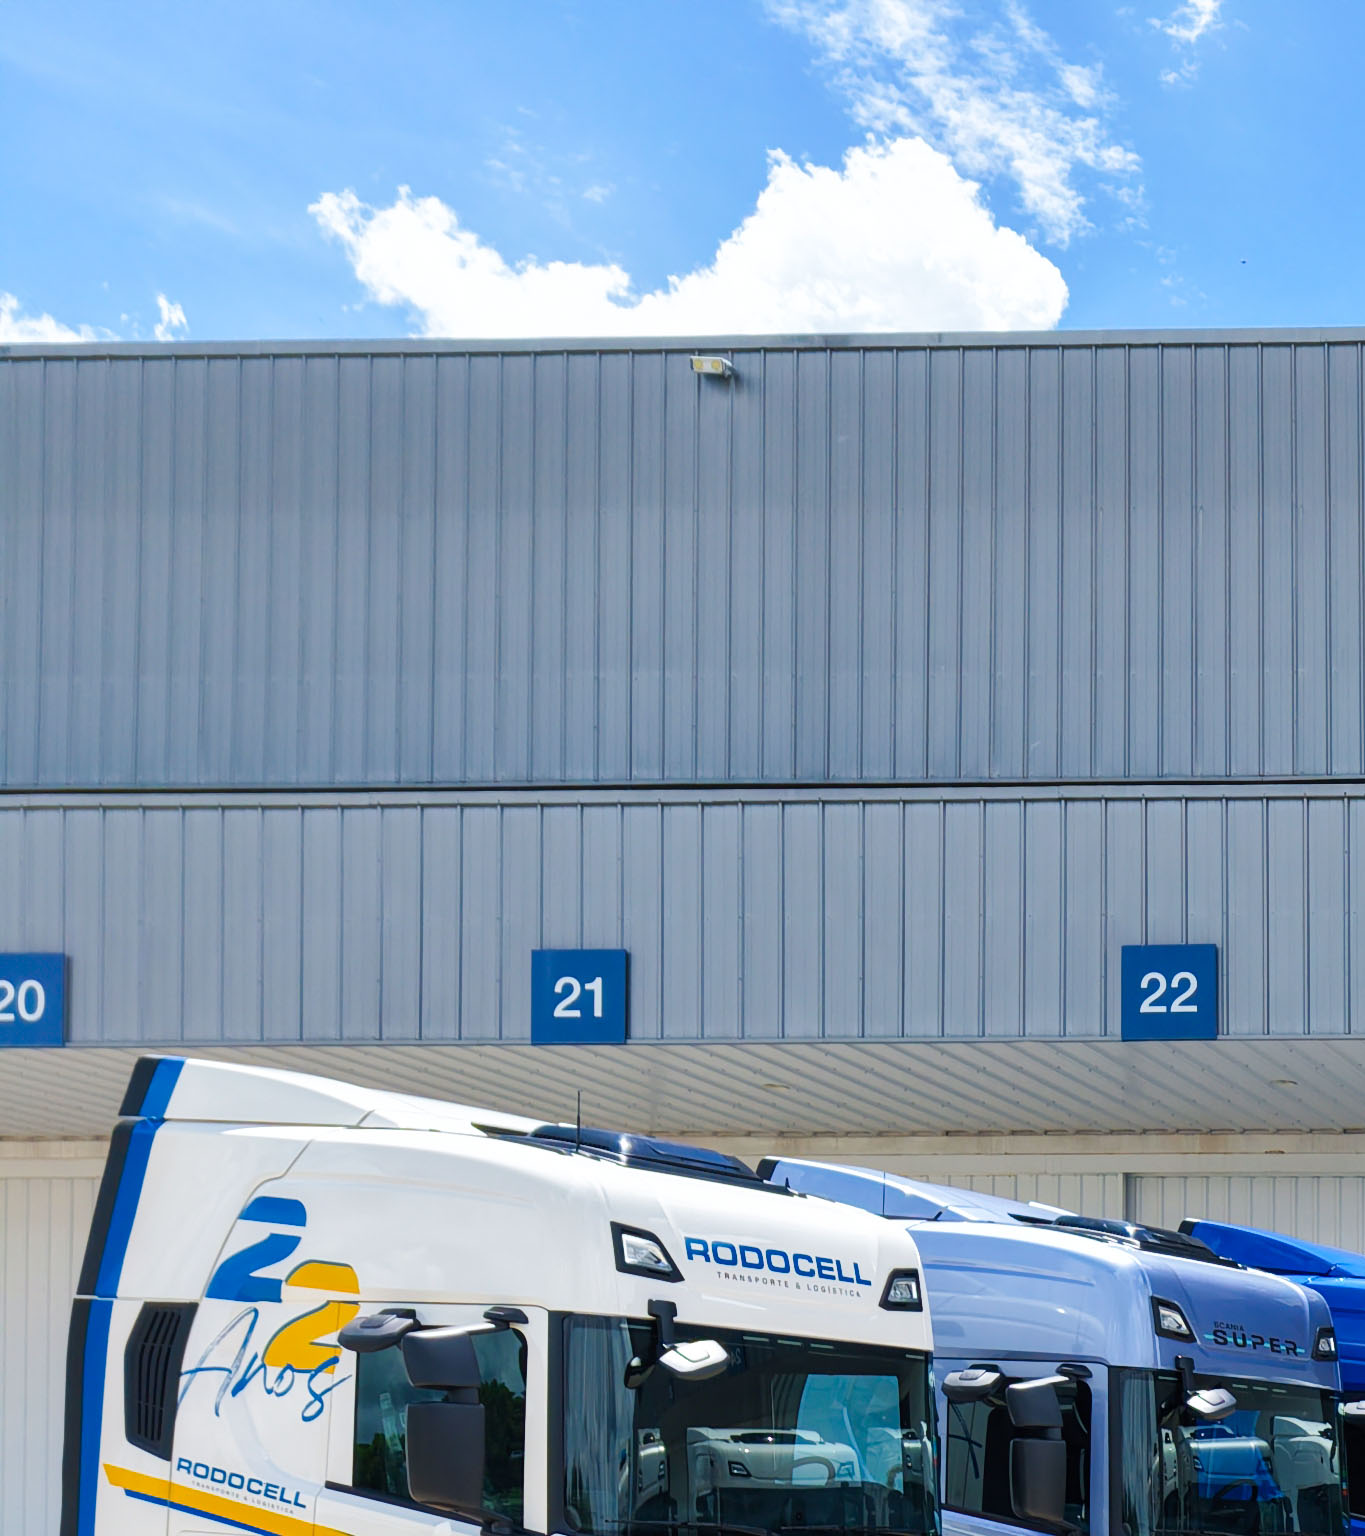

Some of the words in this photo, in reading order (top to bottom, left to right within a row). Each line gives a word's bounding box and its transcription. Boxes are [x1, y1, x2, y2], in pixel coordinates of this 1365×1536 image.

[553, 976, 603, 1018] 21
[1139, 971, 1198, 1013] 22
[684, 1236, 872, 1286] RODOCELL
[717, 1271, 789, 1289] TRANSPORTE
[1212, 1329, 1299, 1357] SUPER
[177, 1457, 307, 1509] RODOCELL
